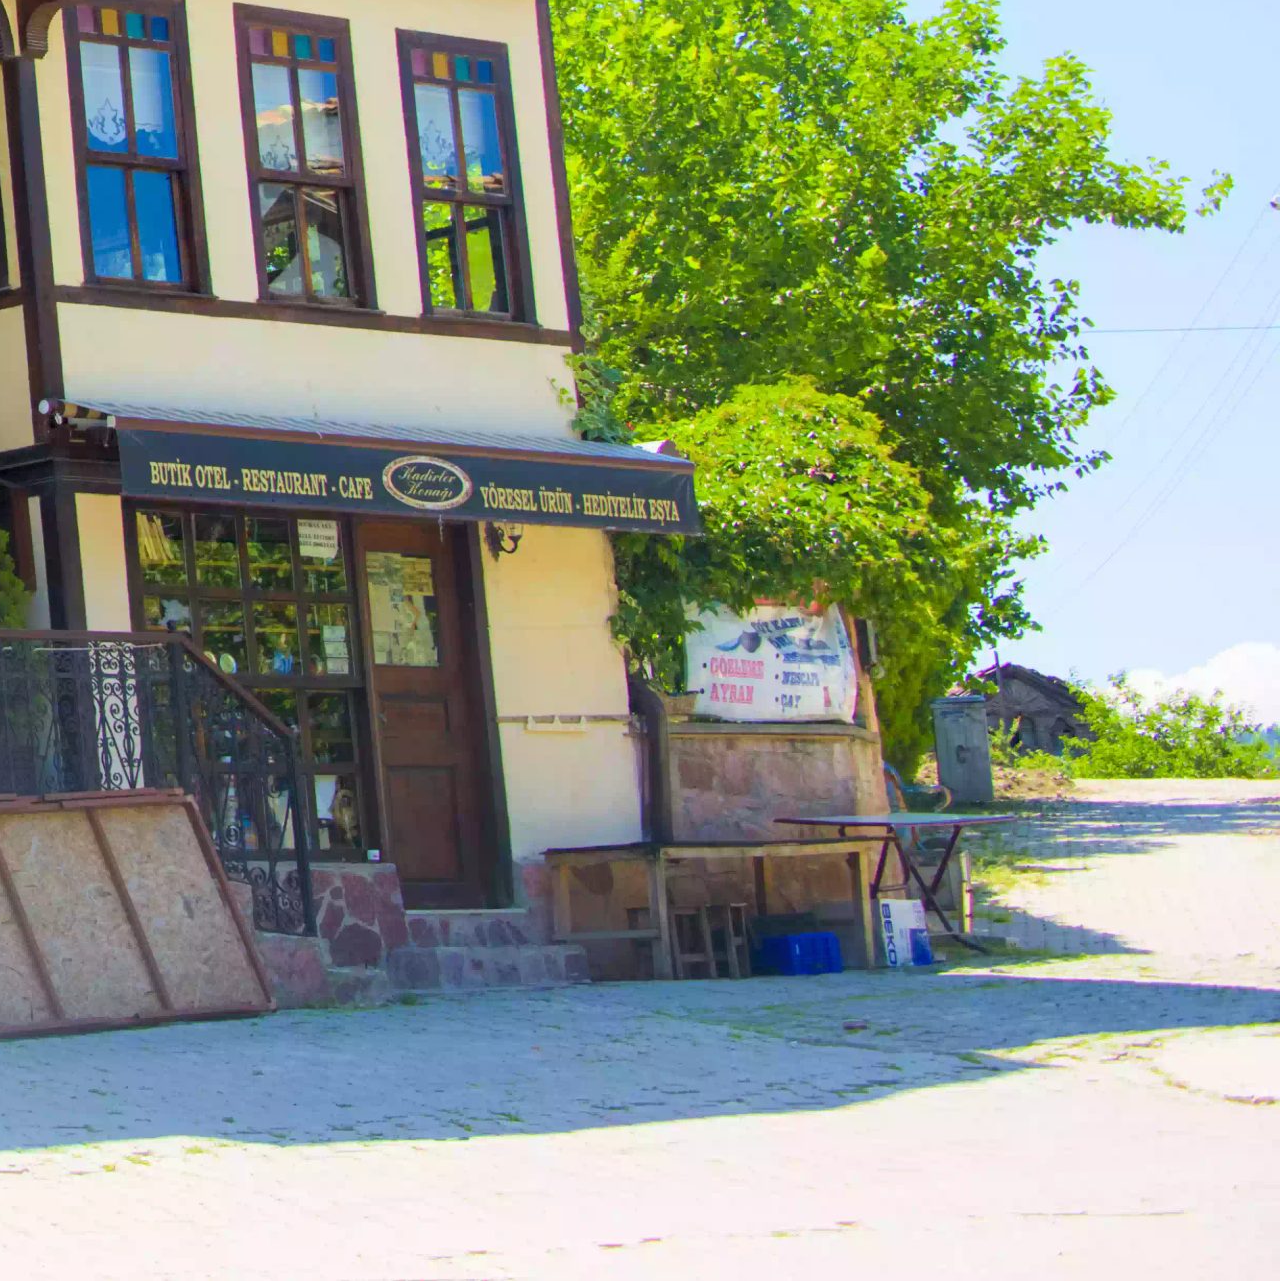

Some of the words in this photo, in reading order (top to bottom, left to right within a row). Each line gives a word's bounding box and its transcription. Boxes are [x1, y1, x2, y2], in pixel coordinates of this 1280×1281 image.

[150, 458, 193, 487] BUTİK
[195, 465, 231, 490] OTEL
[241, 468, 328, 496] RESTAURANT
[339, 476, 373, 500] CAFE
[480, 482, 538, 512] YÖRESEL
[539, 486, 573, 514] ÜRÜN
[583, 490, 647, 520] HEDİYELİK
[649, 499, 680, 526] EŞYA
[710, 683, 754, 704] AYRAN
[882, 903, 897, 965] BEKO
